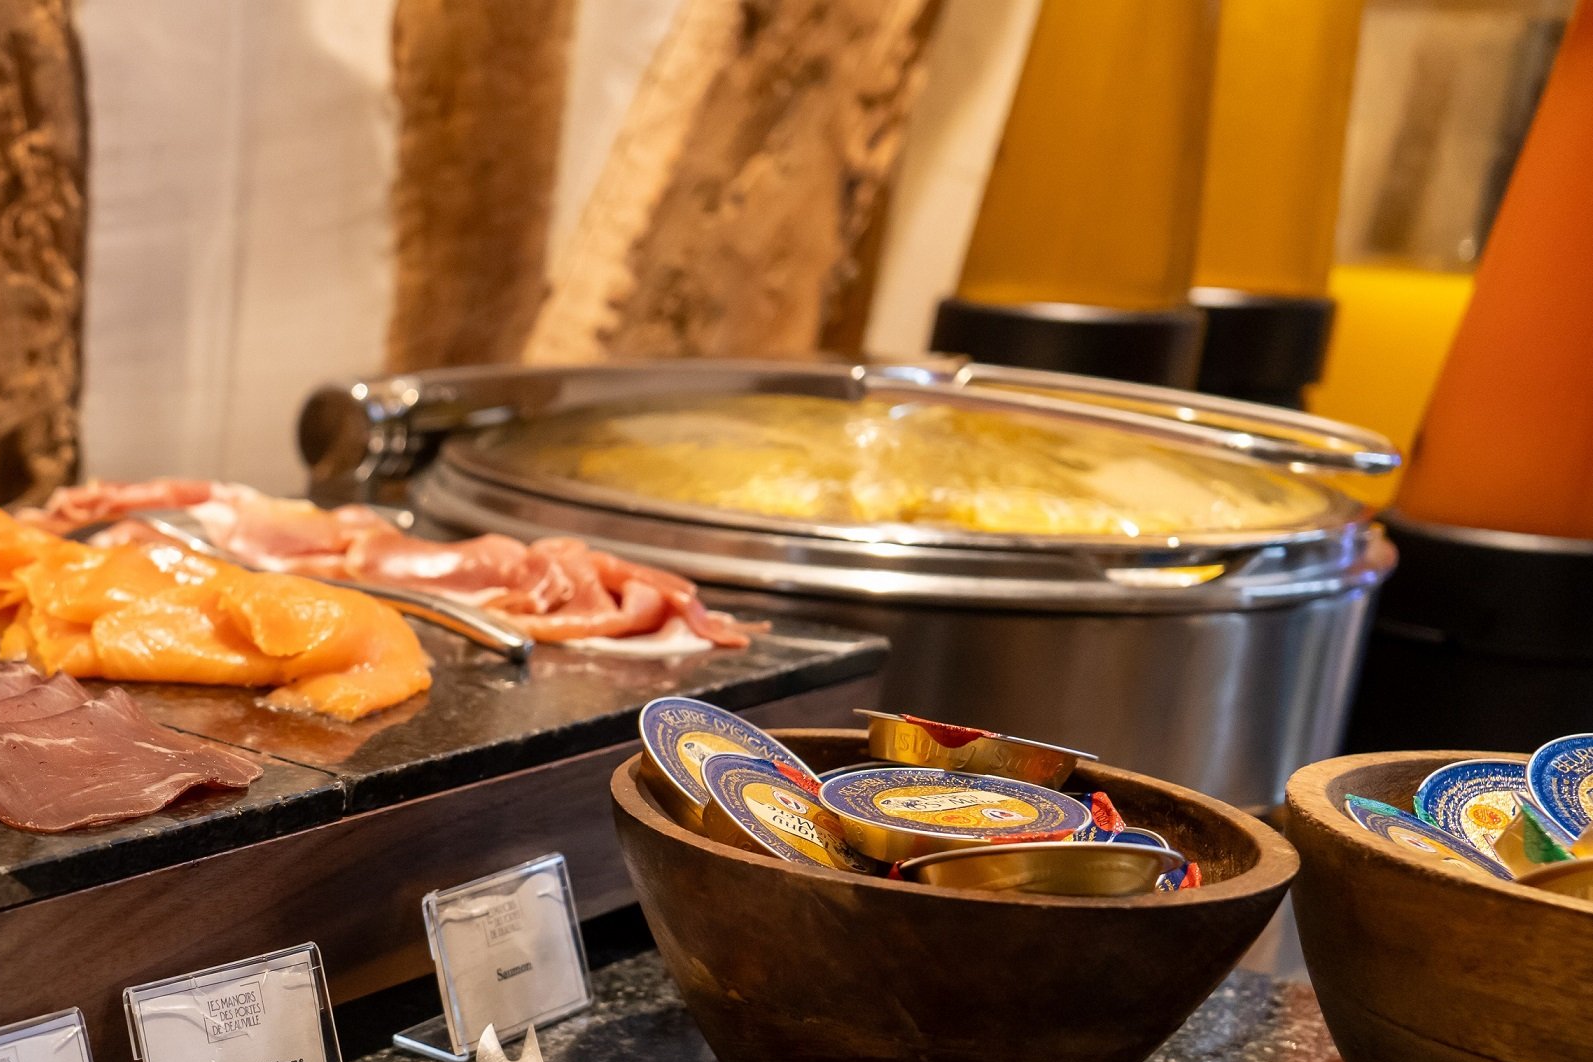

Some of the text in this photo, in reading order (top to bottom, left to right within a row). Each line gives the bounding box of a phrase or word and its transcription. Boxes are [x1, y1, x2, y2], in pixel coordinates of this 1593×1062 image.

[659, 709, 711, 727] BEURRE
[220, 990, 257, 1010] MANOIRS
[219, 1002, 262, 1022] DES PORTES
[211, 1015, 262, 1036] DE DEAUVILLE
